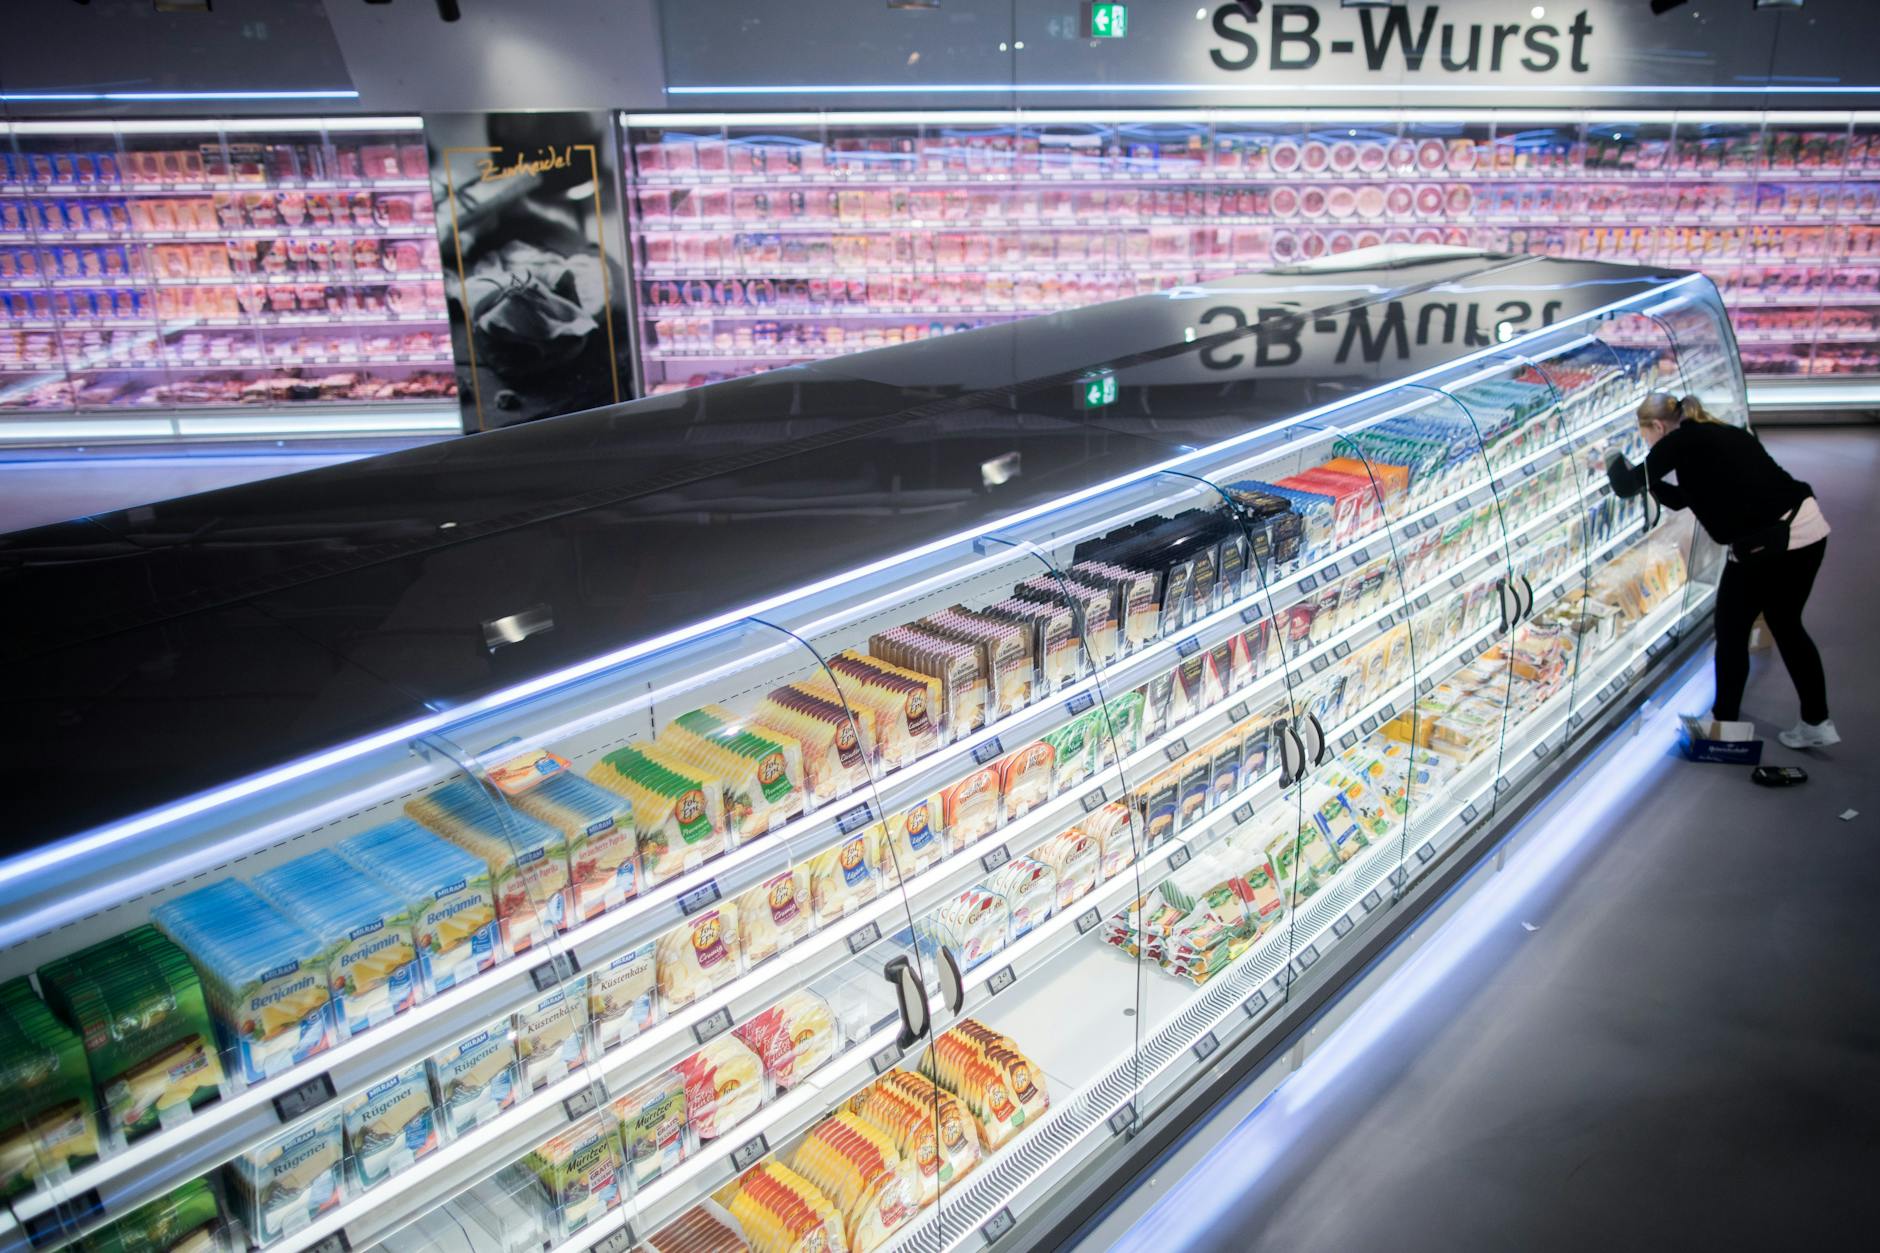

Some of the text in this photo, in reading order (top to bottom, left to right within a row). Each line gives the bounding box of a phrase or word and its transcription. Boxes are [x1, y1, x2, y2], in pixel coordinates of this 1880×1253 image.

[1209, 2, 1593, 73] SB-Wurst
[438, 881, 466, 898] MILRAM
[427, 894, 482, 925] Benjamin
[352, 921, 384, 939] MILRAM
[341, 933, 400, 968] Benjamin
[263, 961, 298, 982] MILRAM
[600, 963, 649, 992] Küstenkäse
[251, 975, 316, 1012] Benjamin
[527, 1002, 582, 1034] Küstenkäse
[454, 1043, 500, 1075] Rügener
[369, 1077, 398, 1098] MILRAM
[362, 1086, 413, 1123] Rügener
[635, 1100, 674, 1131] Müritzer
[273, 1139, 327, 1177] Rügener
[567, 1141, 609, 1174] Müritzer
